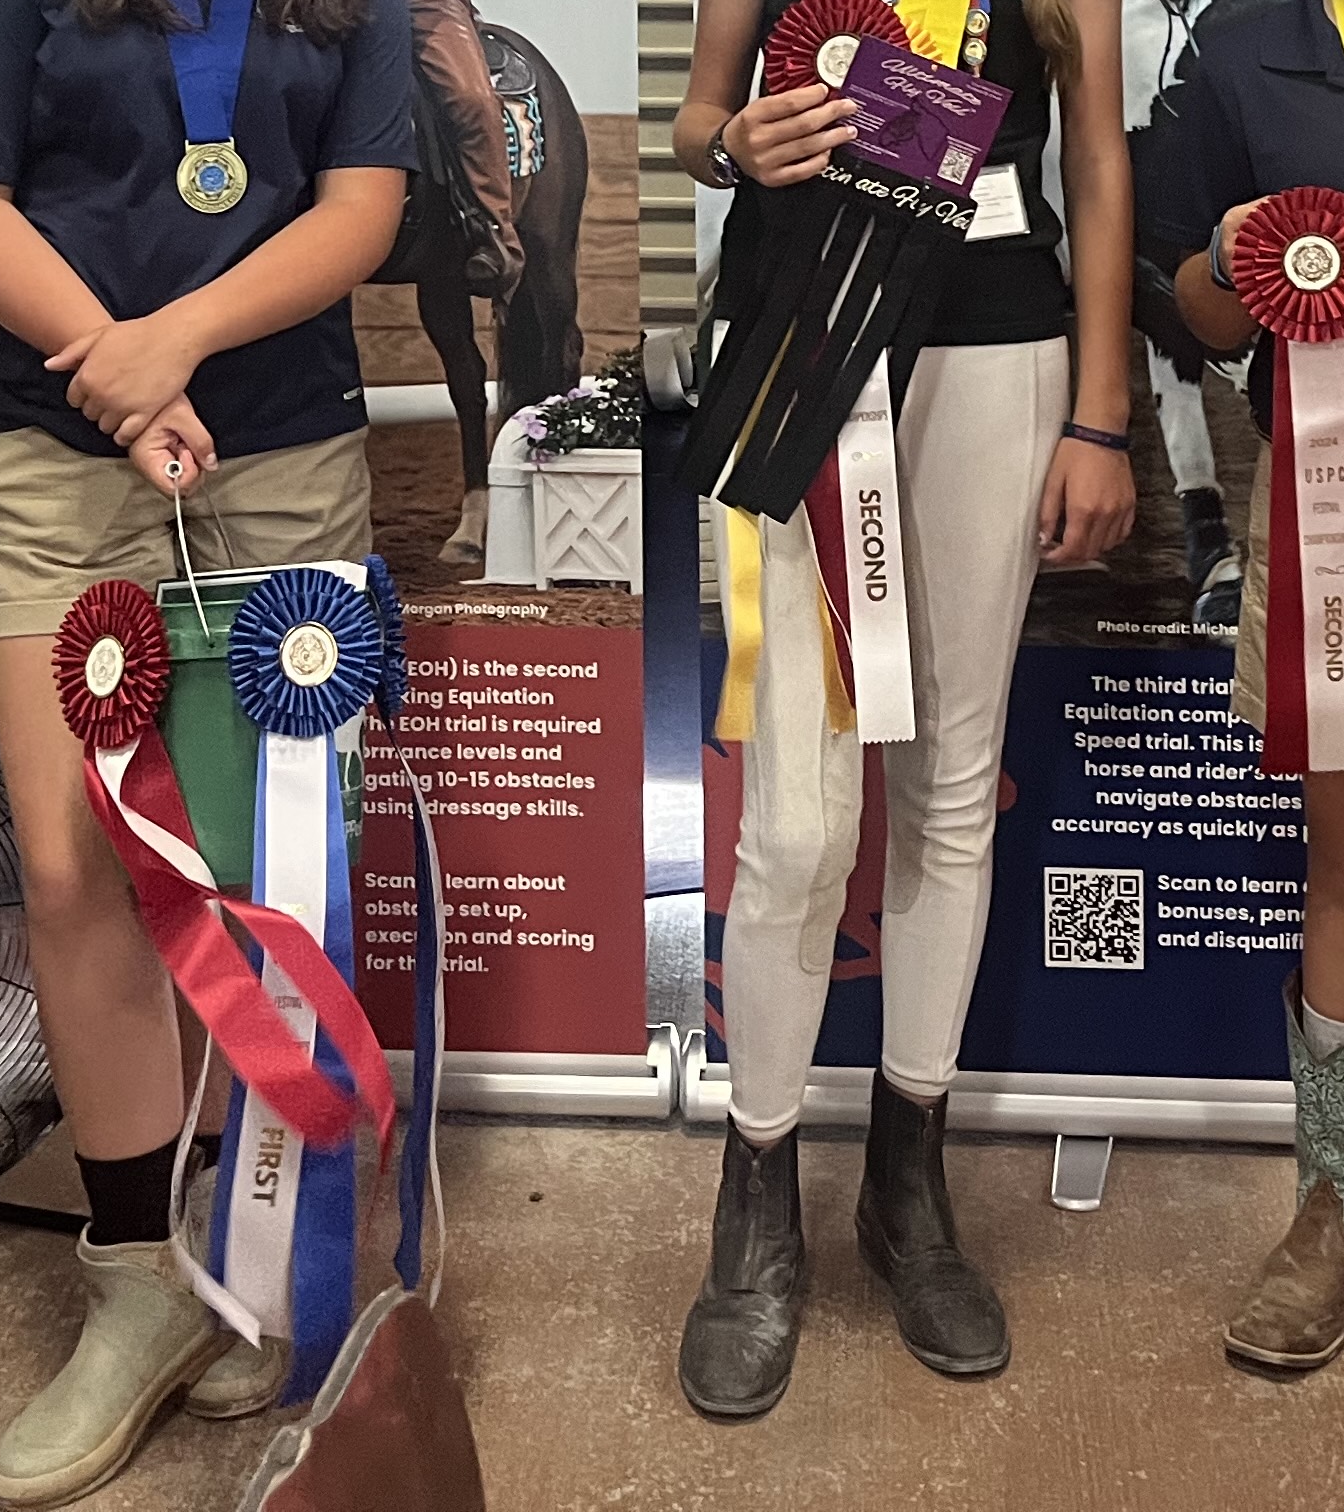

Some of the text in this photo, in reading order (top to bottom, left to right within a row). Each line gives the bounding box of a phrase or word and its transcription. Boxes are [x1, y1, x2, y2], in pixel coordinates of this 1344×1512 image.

[935, 201, 976, 230] Vei
[859, 489, 888, 603] SECOND
[454, 603, 549, 619] Photography
[1097, 620, 1140, 633] Photo
[1143, 621, 1190, 634] credit:
[1323, 595, 1344, 683] SECOND
[462, 659, 480, 677] is
[484, 660, 519, 678] the
[523, 661, 599, 679] second
[1091, 676, 1235, 695] The third trial
[448, 689, 555, 709] Equitation
[1064, 703, 1174, 725] Equitation
[399, 716, 440, 732] EOH
[444, 714, 487, 732] trial
[492, 716, 509, 733] is
[512, 716, 602, 736] required
[457, 743, 517, 761] levels
[521, 744, 563, 762] and
[1074, 732, 1264, 753] Speed trial. This is
[1084, 760, 1145, 778] horse
[1149, 761, 1192, 779] and
[494, 772, 596, 790] obstacles
[426, 799, 522, 820] dressage
[526, 798, 585, 818] skills.
[1096, 790, 1302, 811] navigate obstacles
[1051, 818, 1153, 839] accuracy
[1158, 821, 1184, 835] as
[1188, 820, 1268, 841] quickly
[1272, 823, 1298, 838] as
[364, 872, 566, 891] Scan learn about
[1158, 875, 1211, 892] Scan
[1215, 876, 1238, 892] to
[1241, 876, 1298, 894] learn
[459, 901, 490, 917] set
[495, 904, 528, 923] up,
[1158, 902, 1256, 924] bonuses,
[472, 929, 512, 946] and
[516, 931, 595, 951] scoring
[1158, 931, 1200, 948] and
[366, 953, 395, 970] for
[442, 954, 489, 972] trial.
[252, 1127, 285, 1207] FIRST
